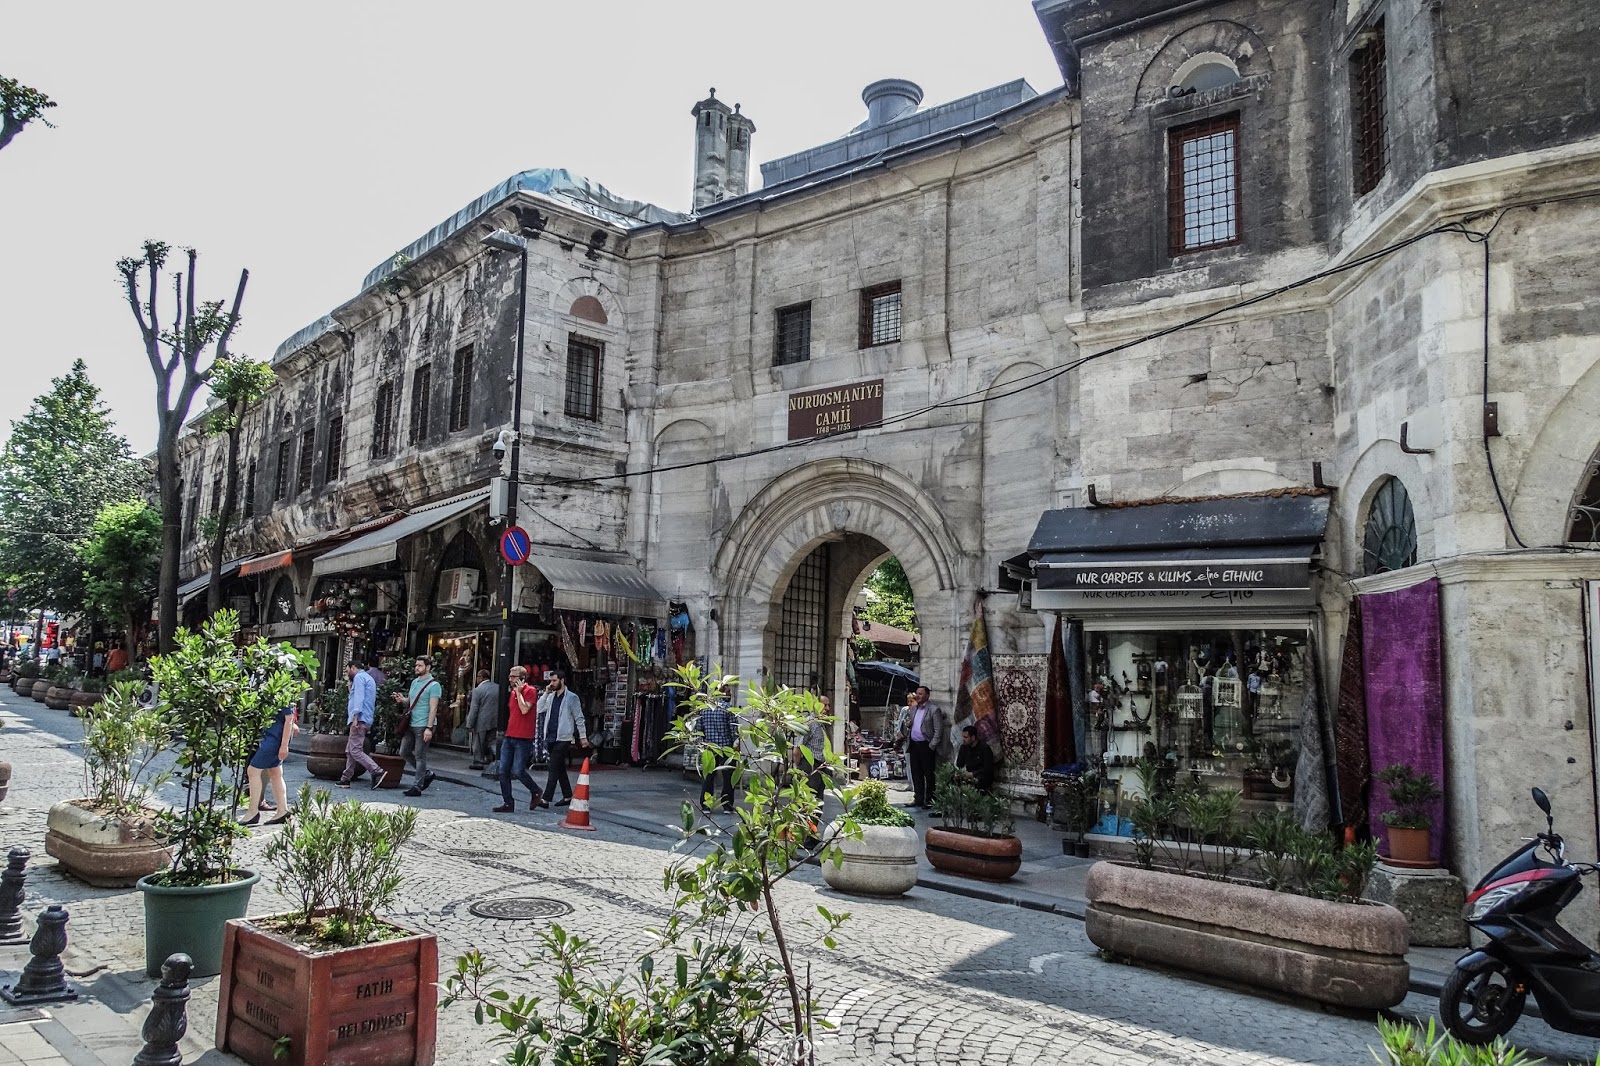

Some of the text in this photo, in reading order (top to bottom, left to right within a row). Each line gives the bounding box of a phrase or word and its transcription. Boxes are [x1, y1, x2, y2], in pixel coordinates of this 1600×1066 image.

[789, 383, 882, 411] NURUOSMANİYE
[816, 405, 851, 427] CAMİİ
[1076, 572, 1099, 584] NUR
[1100, 571, 1144, 584] CARPETS
[1147, 572, 1156, 581] &
[1158, 571, 1192, 583] KILIMS
[1222, 570, 1264, 583] ETHNIC
[355, 976, 394, 999] FATİH
[338, 1006, 408, 1040] BELEDİYESİ
